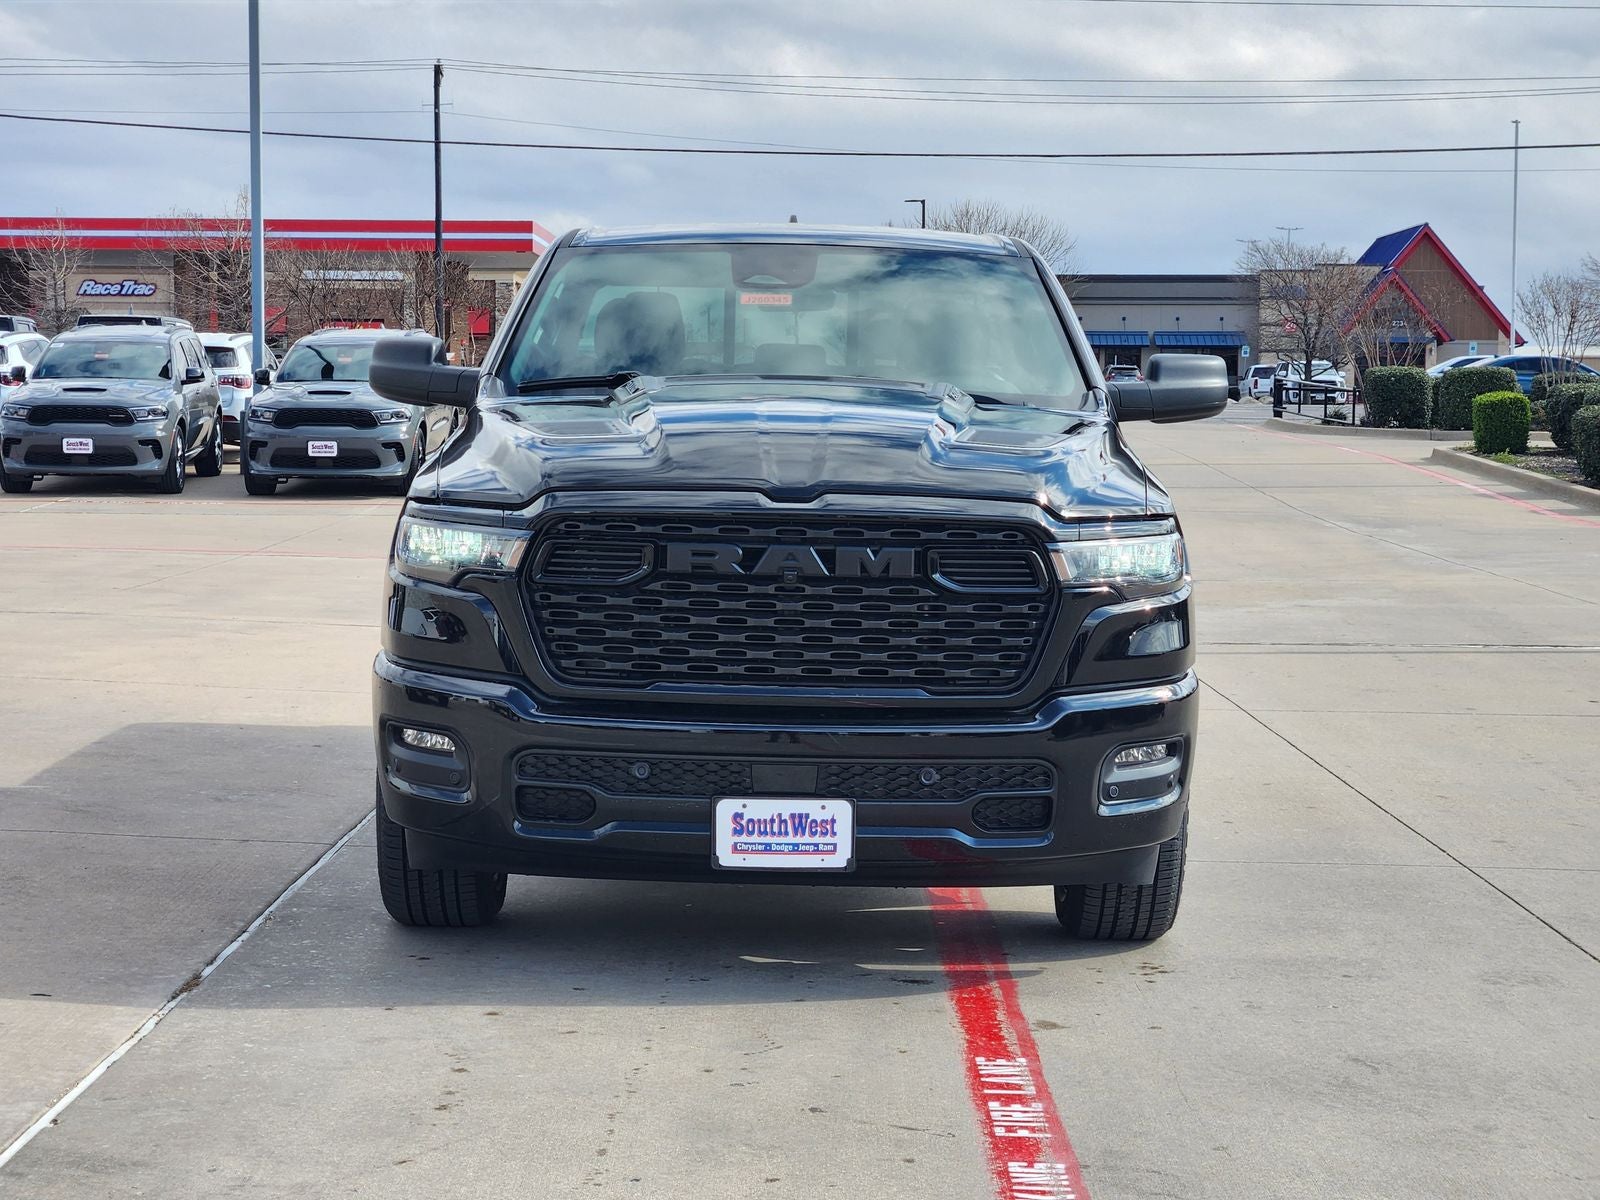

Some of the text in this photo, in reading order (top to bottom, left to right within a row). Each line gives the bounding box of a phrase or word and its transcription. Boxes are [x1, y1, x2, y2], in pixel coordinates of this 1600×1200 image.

[77, 279, 157, 296] RaceTrac
[667, 541, 914, 578] RAM
[731, 811, 837, 838] SouthWest
[736, 843, 766, 852] Chrysler
[771, 843, 793, 852] Dodge
[798, 844, 815, 853] Jeep
[975, 1056, 1036, 1095] LANE
[988, 1101, 1052, 1137] FIRE
